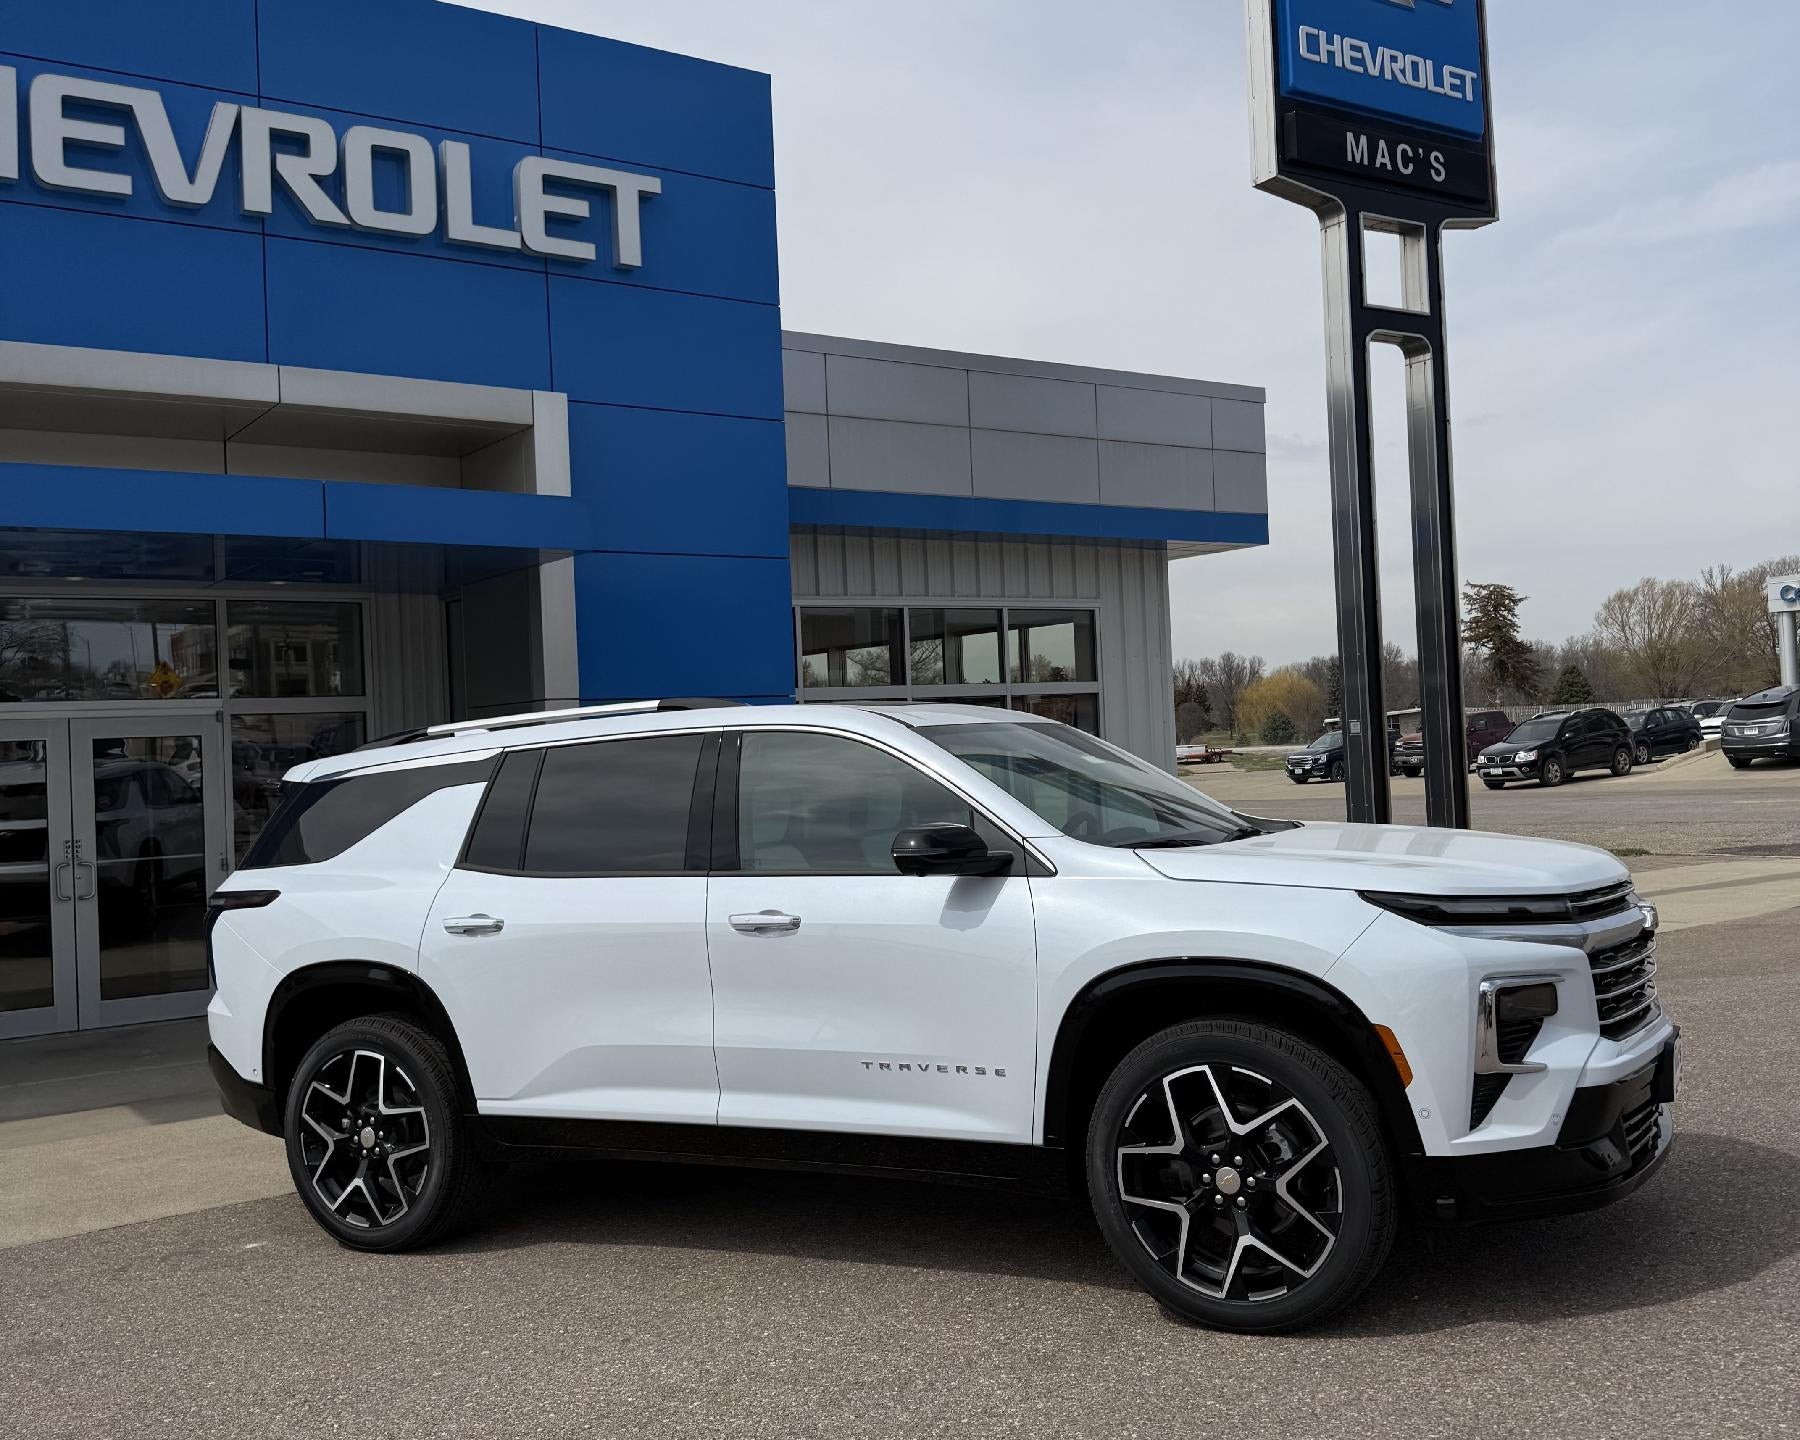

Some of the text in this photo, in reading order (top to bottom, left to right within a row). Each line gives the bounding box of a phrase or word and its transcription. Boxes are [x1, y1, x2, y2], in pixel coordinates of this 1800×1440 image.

[1299, 25, 1478, 103] CHEVROLET
[0, 65, 662, 269] EVROLET
[1346, 131, 1447, 183] MAC'S
[860, 1061, 1007, 1078] TRAVERSE
